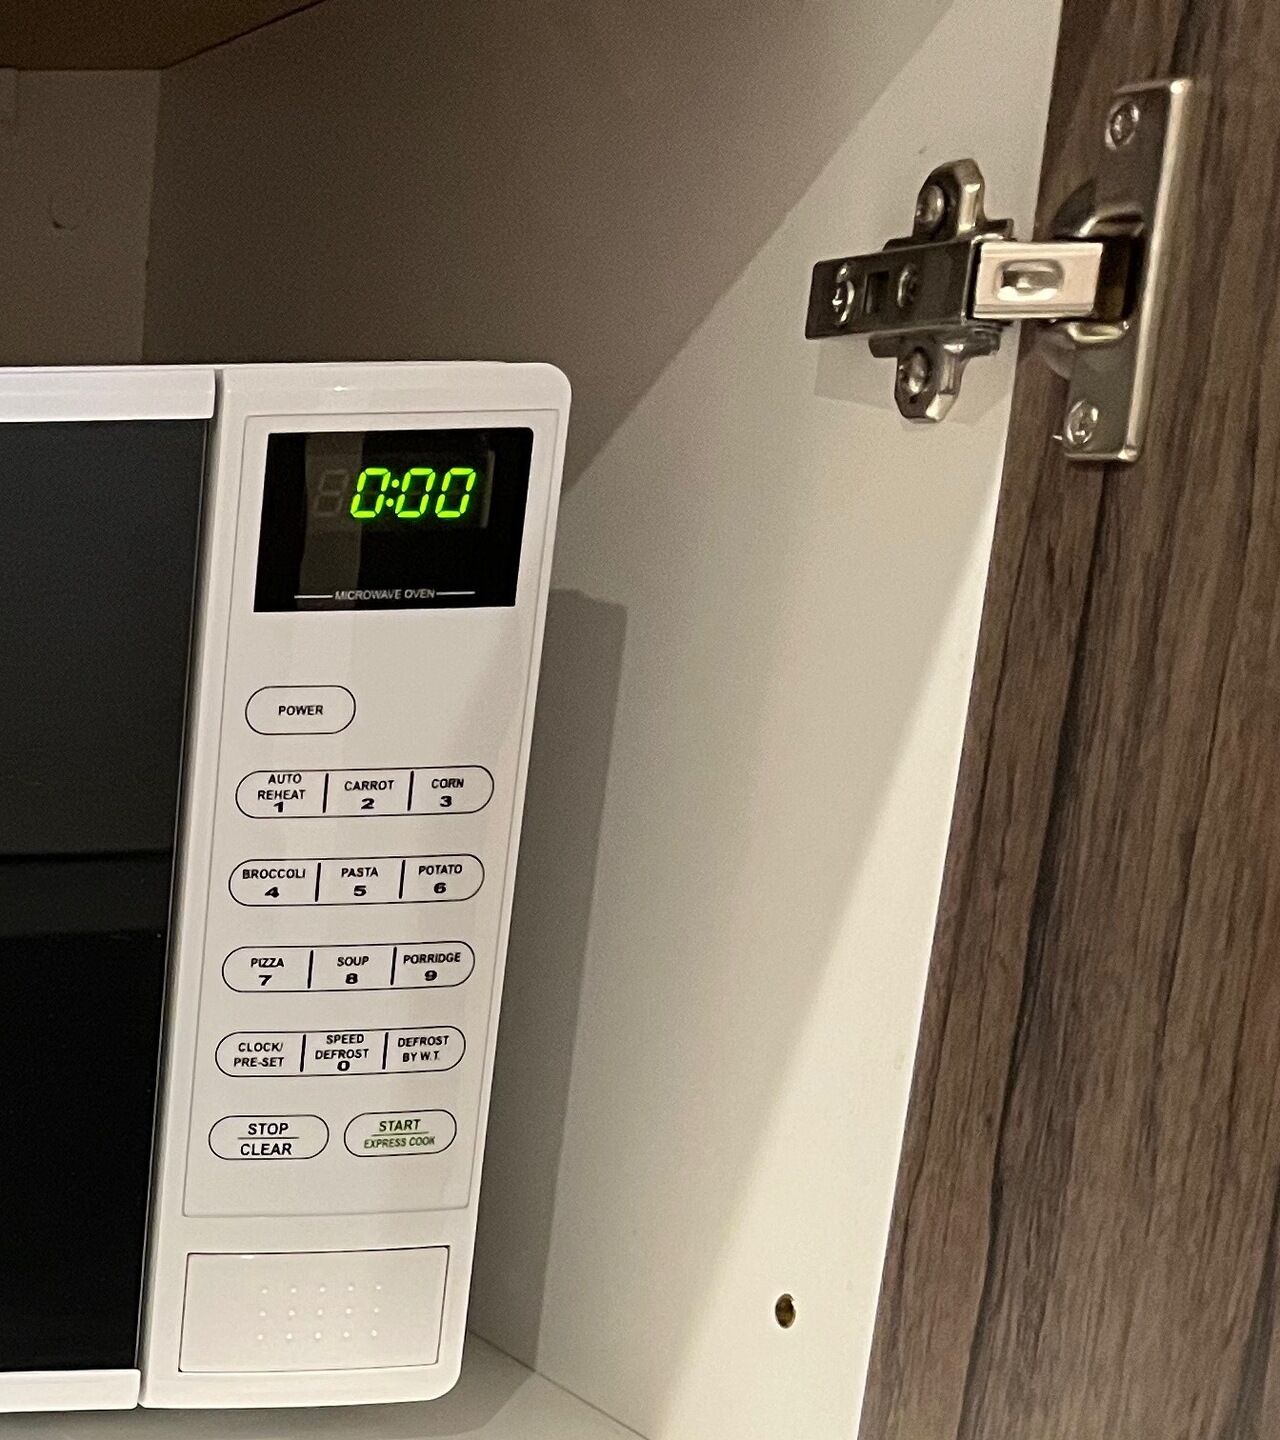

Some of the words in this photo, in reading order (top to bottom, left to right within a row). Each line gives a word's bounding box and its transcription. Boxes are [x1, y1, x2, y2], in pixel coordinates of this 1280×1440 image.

[350, 468, 476, 519] 0:00
[335, 590, 402, 600] MICROWAVE
[404, 589, 435, 599] OVEN
[278, 705, 323, 716] POWER
[268, 773, 302, 785] AUTO
[431, 778, 464, 789] CORN
[344, 780, 395, 791] CARROT
[257, 789, 305, 800] REHEAT
[361, 798, 375, 810] 2
[439, 796, 452, 807] 3
[273, 802, 284, 813] 1
[242, 868, 306, 879] BROCCOLI
[341, 867, 379, 878] PASTA
[418, 864, 463, 876] POTATO
[265, 887, 280, 898] 4
[353, 885, 367, 897] 5
[433, 882, 447, 894] 6
[250, 957, 284, 968] PIZZA
[337, 955, 369, 967] SOUP
[403, 952, 461, 964] PORRIDGE
[258, 975, 272, 986] 7
[345, 973, 358, 985] 8
[424, 970, 438, 982] 9
[326, 1034, 364, 1045] SPEED
[398, 1036, 449, 1047] DEFROST
[238, 1042, 284, 1053] CLOCK/
[315, 1048, 369, 1060] DEFROST
[402, 1052, 418, 1062] BY
[233, 1057, 284, 1068] PRE-SET
[337, 1061, 349, 1072] 0
[247, 1123, 289, 1135] STOP
[379, 1119, 420, 1131] START
[364, 1137, 407, 1149] EXPRESS
[409, 1136, 435, 1147] COOK
[240, 1143, 292, 1155] CLEAR
